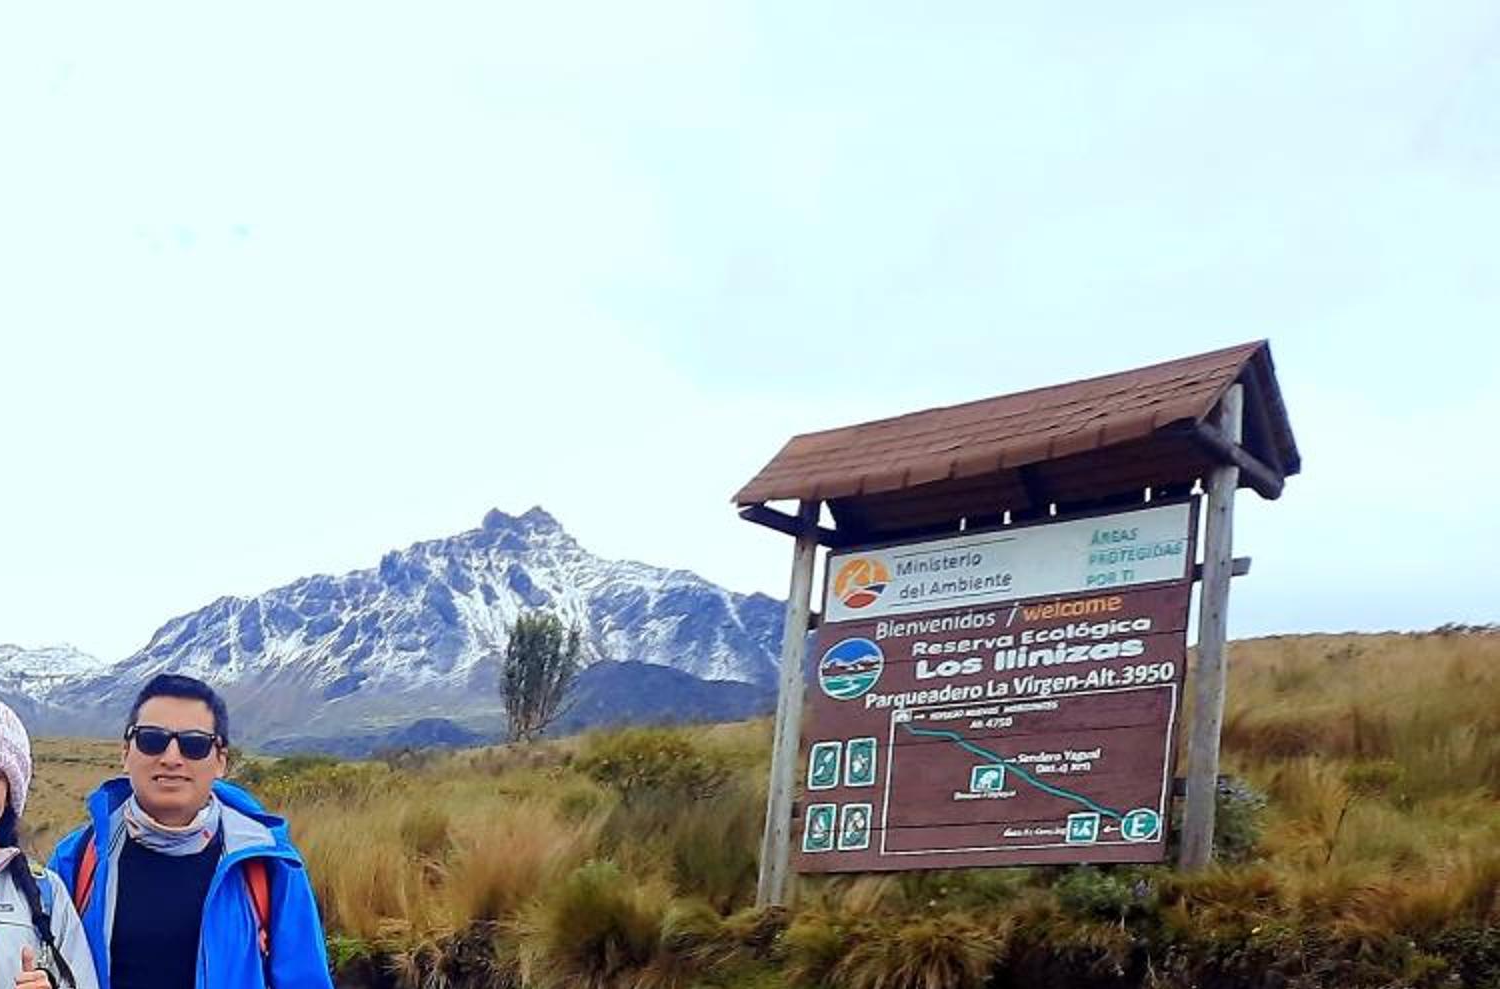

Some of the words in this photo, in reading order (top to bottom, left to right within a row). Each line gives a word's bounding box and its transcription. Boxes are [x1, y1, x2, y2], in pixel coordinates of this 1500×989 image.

[896, 551, 982, 576] Ministerio
[900, 582, 925, 599] del
[929, 573, 1012, 595] Ambiente
[875, 608, 997, 641] Bienvenidos
[1022, 594, 1124, 621] welcome
[912, 634, 1015, 657] Reserva
[1021, 617, 1152, 645] Ecológica
[916, 656, 983, 680] Los
[865, 684, 983, 709] Parqueadero
[986, 679, 1009, 697] La
[1130, 814, 1150, 837] E
